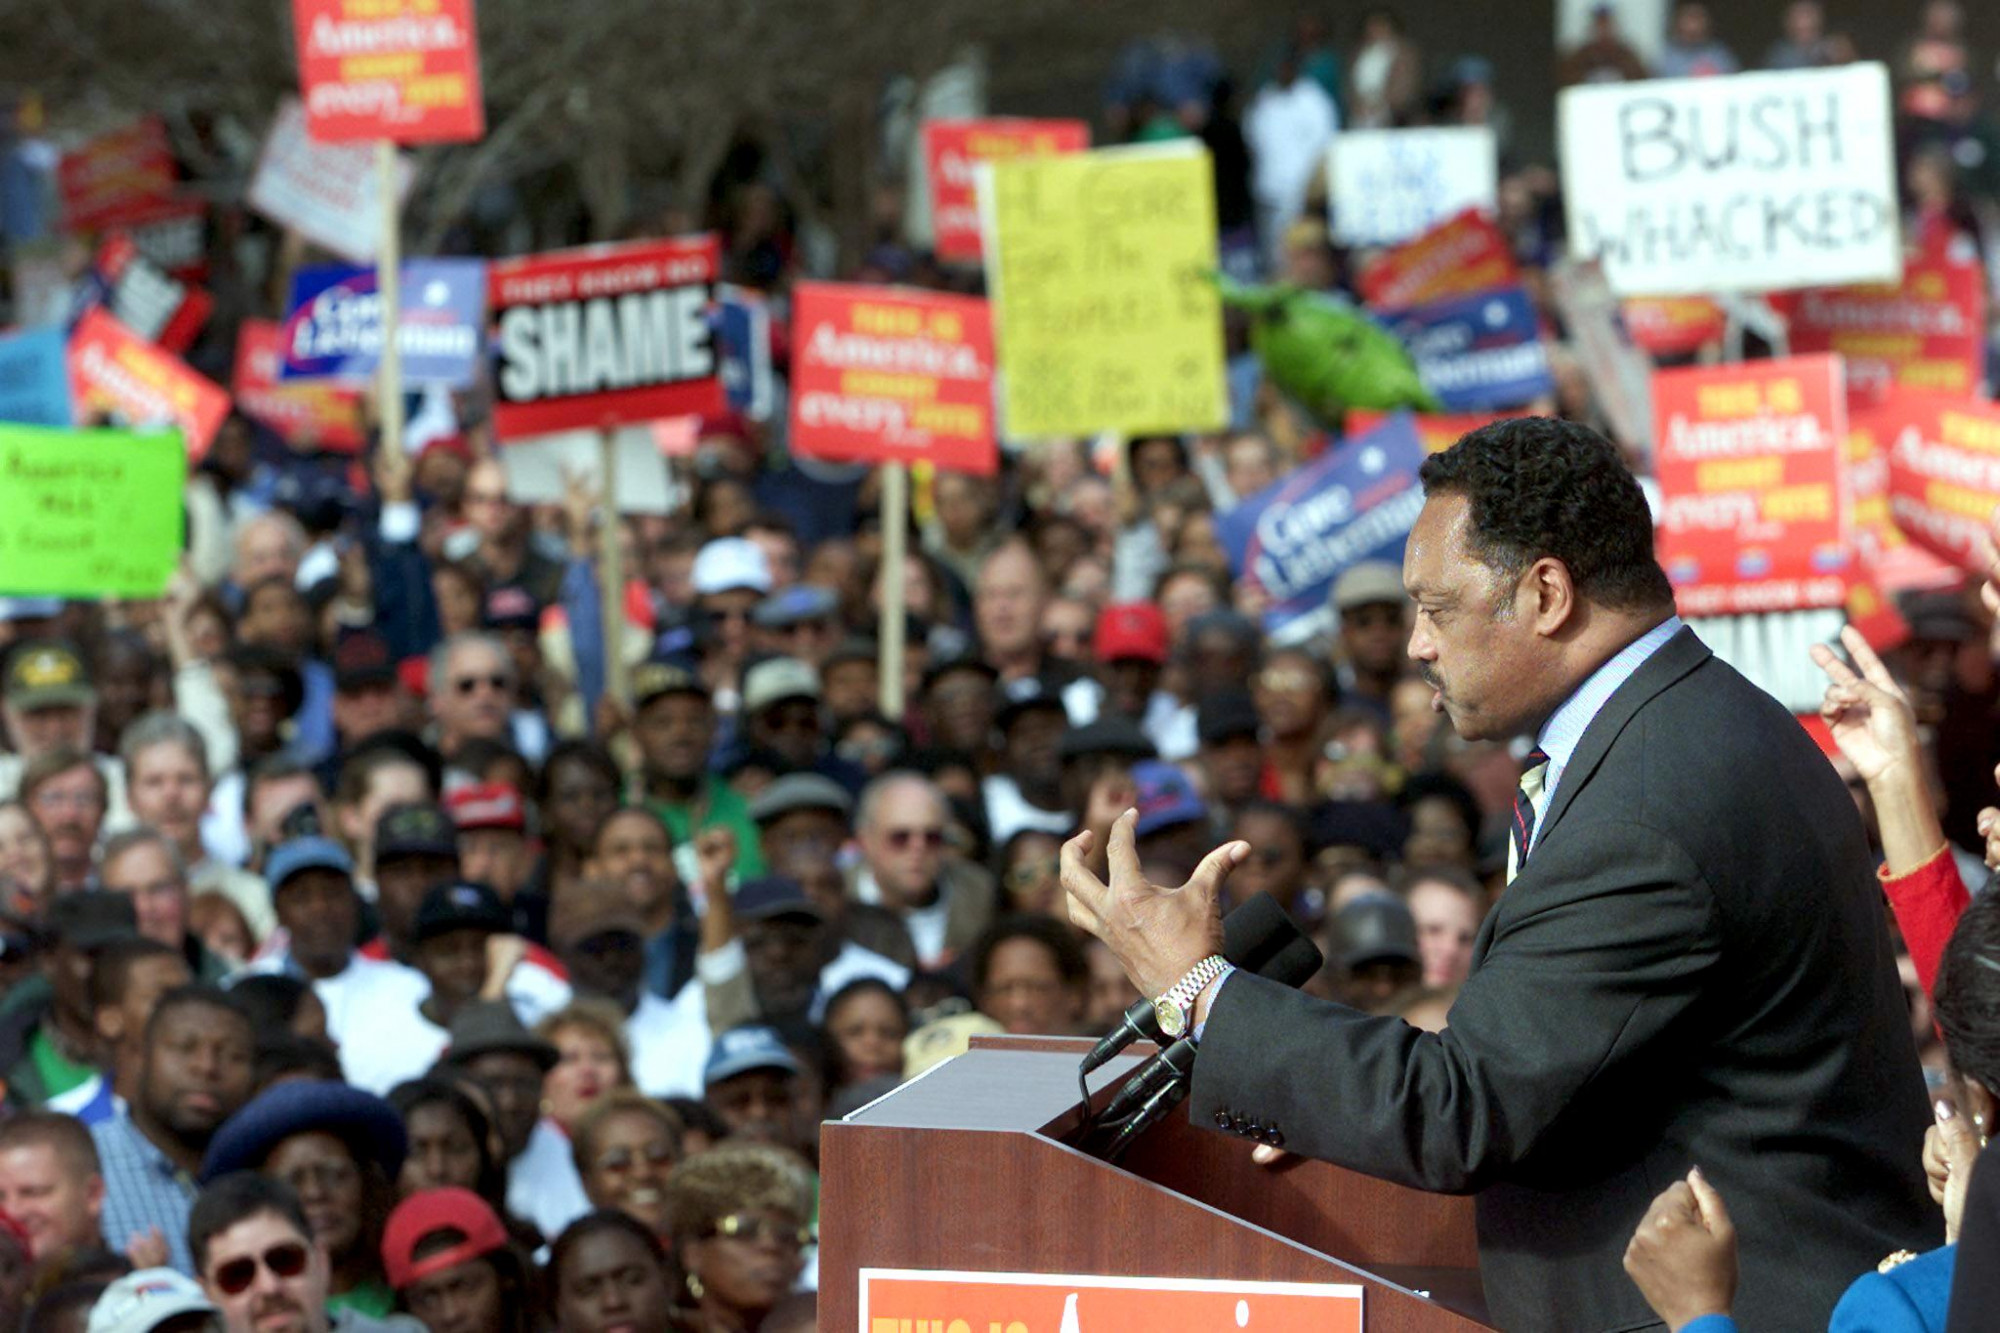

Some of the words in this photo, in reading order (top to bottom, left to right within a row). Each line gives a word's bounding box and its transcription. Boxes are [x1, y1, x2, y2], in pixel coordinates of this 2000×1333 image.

[1619, 94, 1841, 183] BUSH
[1584, 193, 1886, 265] WHACKED
[500, 285, 714, 403] SHAME
